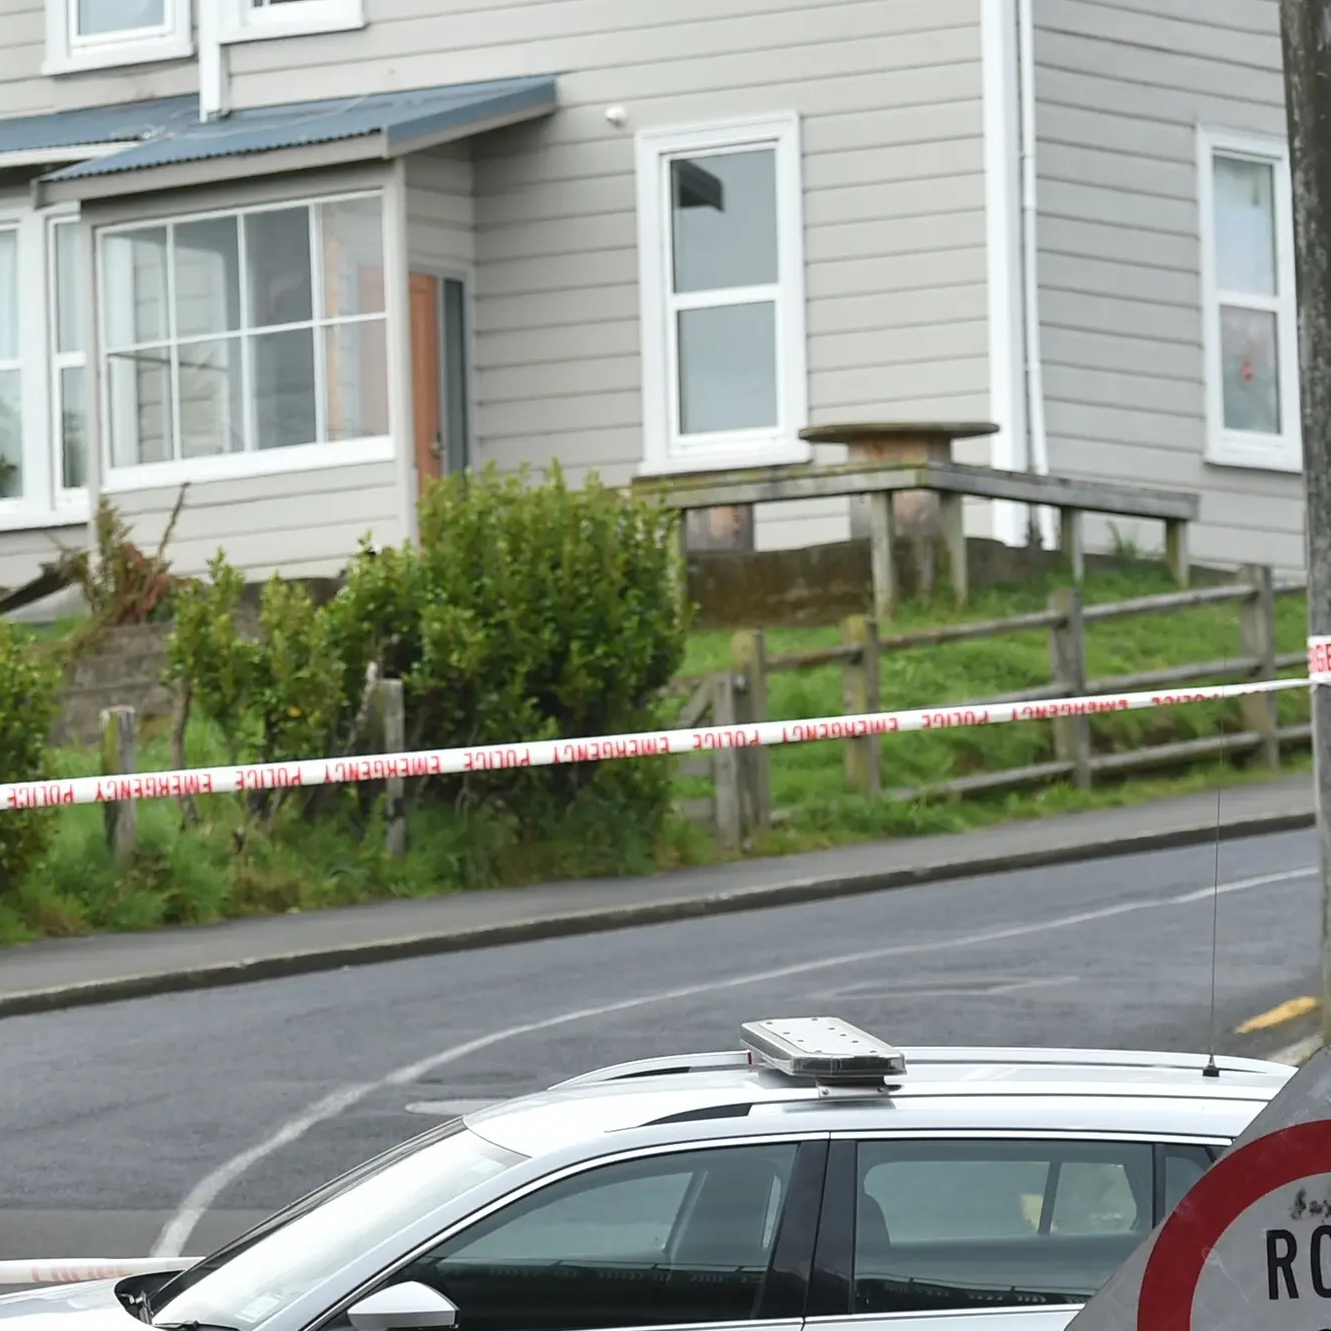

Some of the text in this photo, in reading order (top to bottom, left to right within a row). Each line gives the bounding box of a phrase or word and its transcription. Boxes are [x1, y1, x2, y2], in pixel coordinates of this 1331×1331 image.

[782, 717, 900, 743] EMERGENCY
[922, 711, 989, 728] POLICE
[553, 737, 671, 764] EMERGENCY
[693, 730, 761, 751] POLICE
[324, 755, 442, 783] EMERGENCY
[464, 748, 531, 770] POLICE
[96, 774, 213, 802] EMERGENCY
[235, 766, 302, 790] POLICE
[7, 784, 75, 808] POLICE
